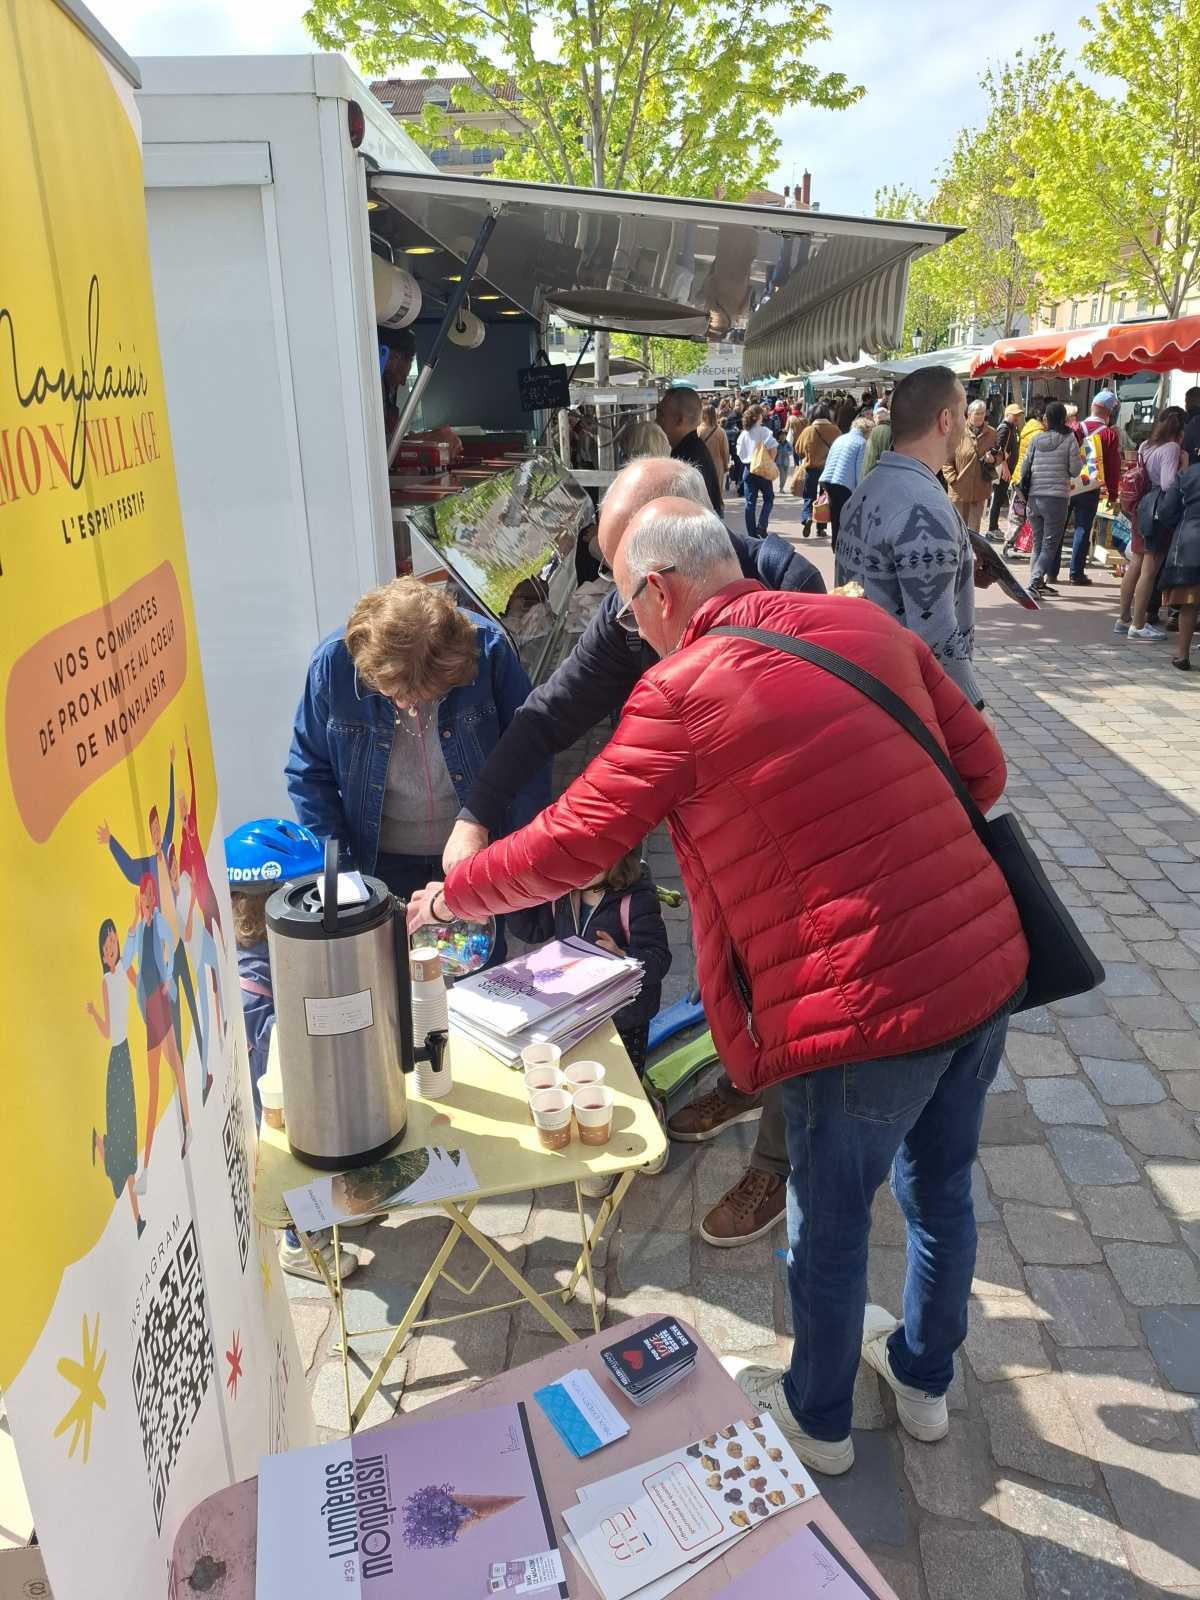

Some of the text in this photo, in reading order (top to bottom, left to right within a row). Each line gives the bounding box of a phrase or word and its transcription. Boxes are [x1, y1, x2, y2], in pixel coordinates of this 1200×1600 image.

[81, 411, 160, 479] VILLAGE
[61, 491, 146, 544] L'ESPRIT FESTIF
[54, 595, 158, 685] VOS COMMERCES
[39, 718, 56, 757] DE
[138, 643, 149, 672] AU
[151, 618, 175, 658] COEUR
[76, 669, 167, 768] DE MONPLAISIR
[226, 867, 261, 881] IDDY
[129, 1213, 180, 1345] INSTAGRAM
[758, 1400, 772, 1409] FILA
[343, 1560, 355, 1582] #39
